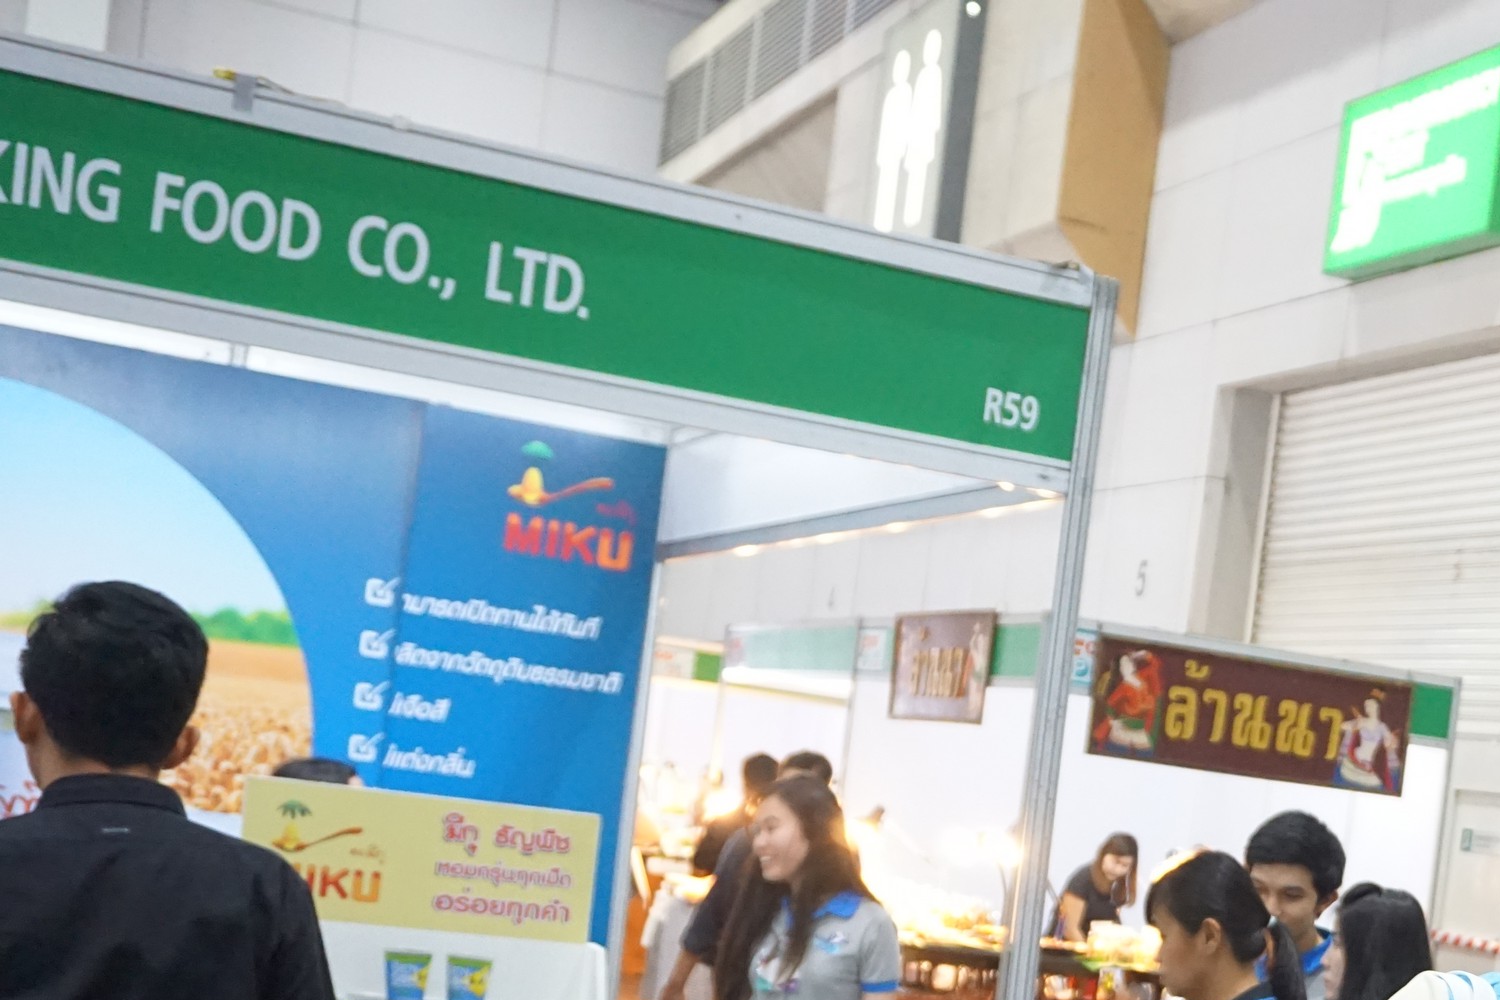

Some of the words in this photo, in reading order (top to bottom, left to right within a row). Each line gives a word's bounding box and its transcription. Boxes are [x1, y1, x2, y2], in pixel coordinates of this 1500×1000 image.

[0, 139, 122, 223] ING
[150, 171, 322, 261] FOOD
[348, 215, 456, 299] CO.,
[485, 241, 590, 320] LTD.
[983, 386, 1039, 432] R59
[504, 512, 634, 572] MIKU
[1135, 560, 1149, 597] 5
[1165, 659, 1344, 760] ล้านนา
[294, 864, 382, 903] IKU
